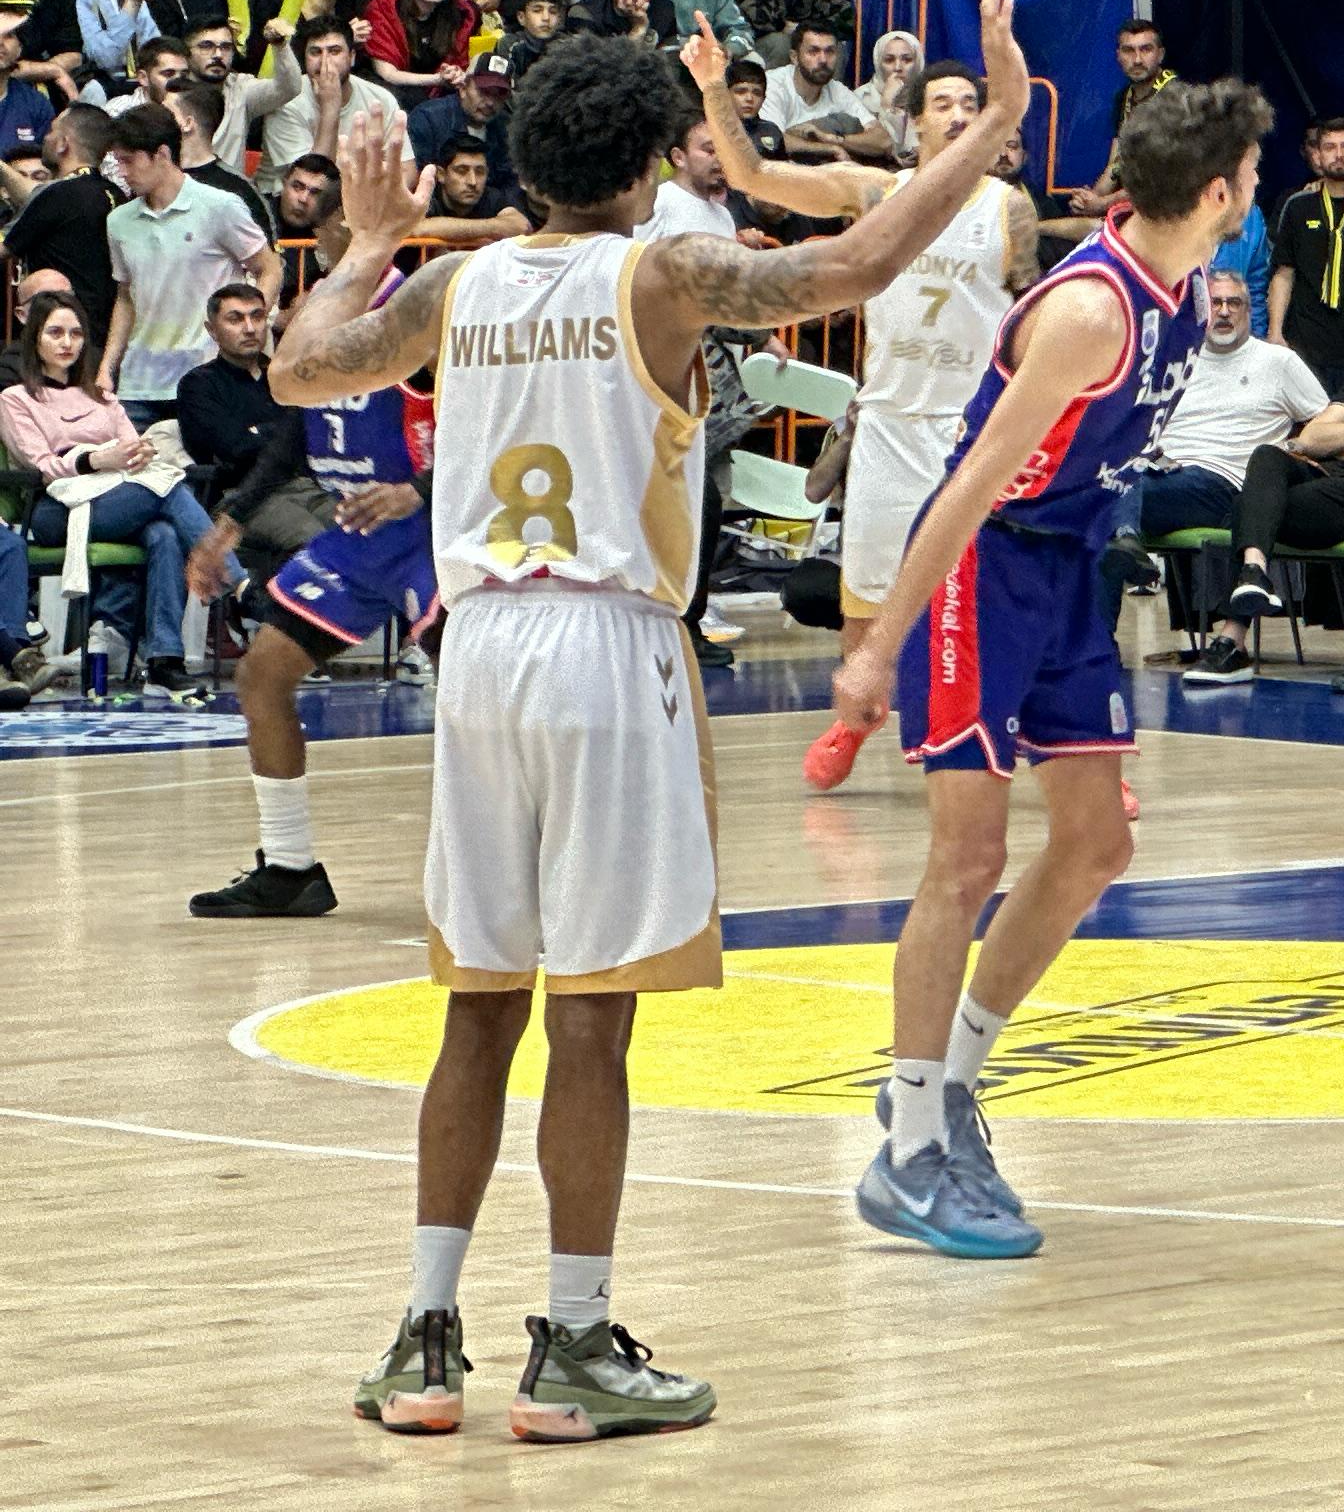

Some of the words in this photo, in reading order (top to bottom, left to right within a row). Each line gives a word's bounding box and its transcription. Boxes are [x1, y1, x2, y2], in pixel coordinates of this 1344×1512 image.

[919, 285, 952, 328] 7
[451, 316, 617, 368] WILLIAMS
[485, 443, 578, 568] 8
